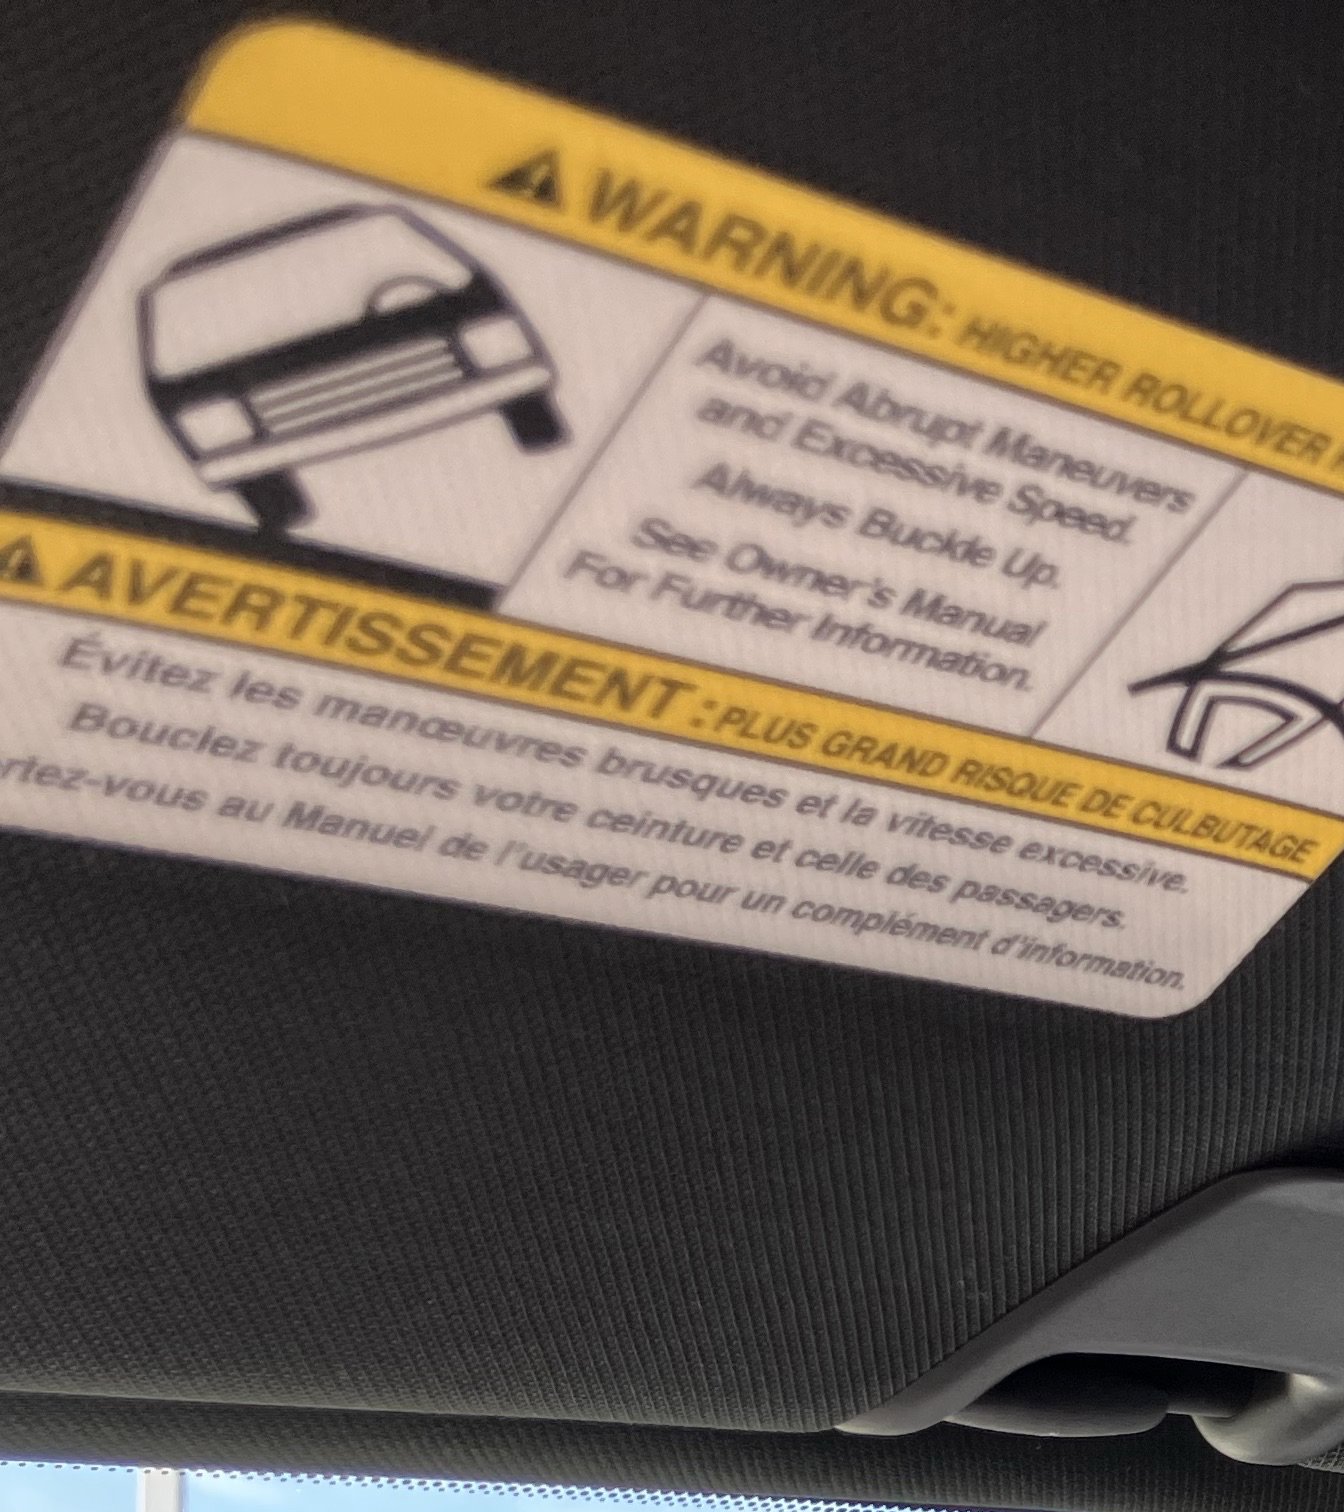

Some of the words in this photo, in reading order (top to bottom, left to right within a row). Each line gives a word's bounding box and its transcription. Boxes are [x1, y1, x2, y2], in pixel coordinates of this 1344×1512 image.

[586, 165, 956, 339] WARNING:
[955, 316, 1123, 392] HIGHER
[1121, 372, 1333, 466] ROLLOVER
[694, 338, 836, 402] Avoid
[831, 381, 984, 447] Abrupt
[984, 426, 1195, 513] Maneuvers
[696, 398, 793, 441] and
[791, 417, 1003, 504] Excessive
[1007, 483, 1137, 545] Speed.
[631, 516, 720, 563] See
[725, 542, 897, 609] Owner's
[899, 587, 1049, 648] Manual
[690, 462, 852, 530] Always
[857, 506, 996, 568] Buckle
[1001, 547, 1060, 590] Up.
[564, 550, 648, 594] For
[650, 571, 811, 632] Further
[811, 613, 1034, 692] Information.
[57, 631, 223, 695] Évitez
[226, 669, 304, 711] les
[312, 692, 588, 768] manœuvres
[596, 746, 790, 810] brusques
[795, 792, 834, 820] et
[841, 797, 880, 827] la
[887, 808, 1011, 855] vitesse
[1018, 838, 1190, 894] excessive.
[68, 700, 268, 764] Bouclez
[272, 741, 463, 801] toujours
[474, 783, 578, 824] votre
[585, 805, 746, 856] ceinture
[751, 836, 793, 865] et
[793, 847, 880, 881] celle
[885, 861, 948, 895] des
[950, 876, 1128, 930] passagers.
[712, 705, 818, 750] PLUS
[819, 729, 947, 778] GRAND
[949, 758, 1081, 808] RISQUE
[1080, 787, 1131, 819] DE
[1126, 798, 1321, 866] CULBUTAGE
[0, 754, 211, 813] rtez-vous
[216, 794, 275, 825] au
[282, 800, 436, 854] Manuel
[436, 830, 489, 864] de
[493, 838, 650, 890] l'usager
[645, 870, 739, 905] pour
[739, 888, 788, 915] un
[791, 896, 993, 953] complément
[990, 927, 1187, 992] d'information.
